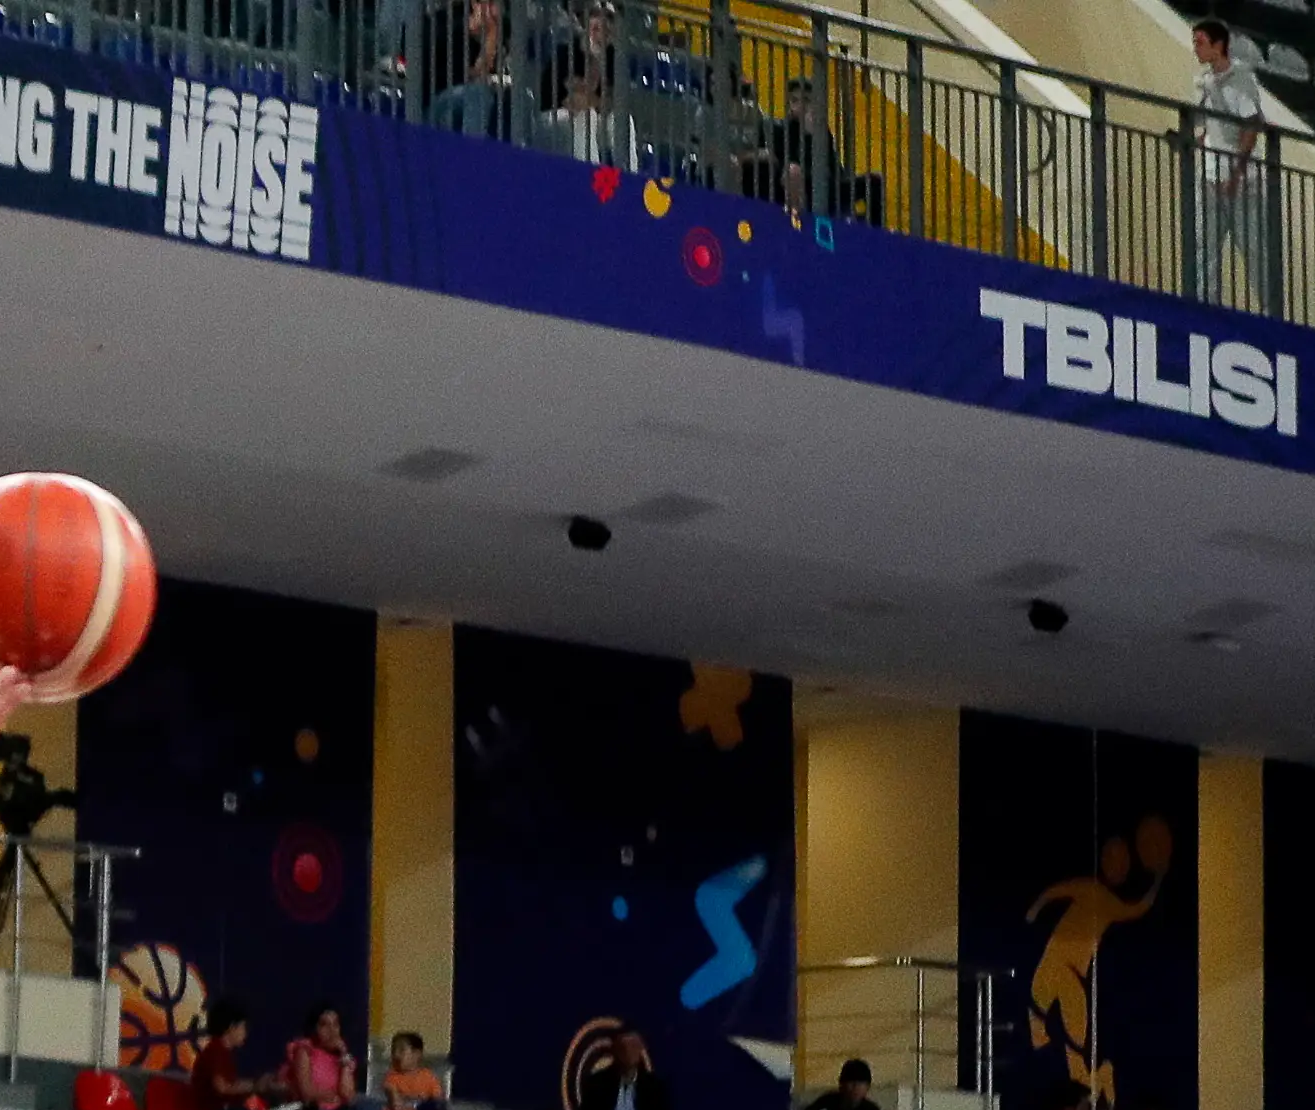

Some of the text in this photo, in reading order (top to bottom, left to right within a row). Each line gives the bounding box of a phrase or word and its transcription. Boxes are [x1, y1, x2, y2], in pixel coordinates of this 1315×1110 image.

[65, 89, 162, 197] THE
[164, 77, 318, 260] NOISE
[980, 287, 1298, 437] TBILISI
